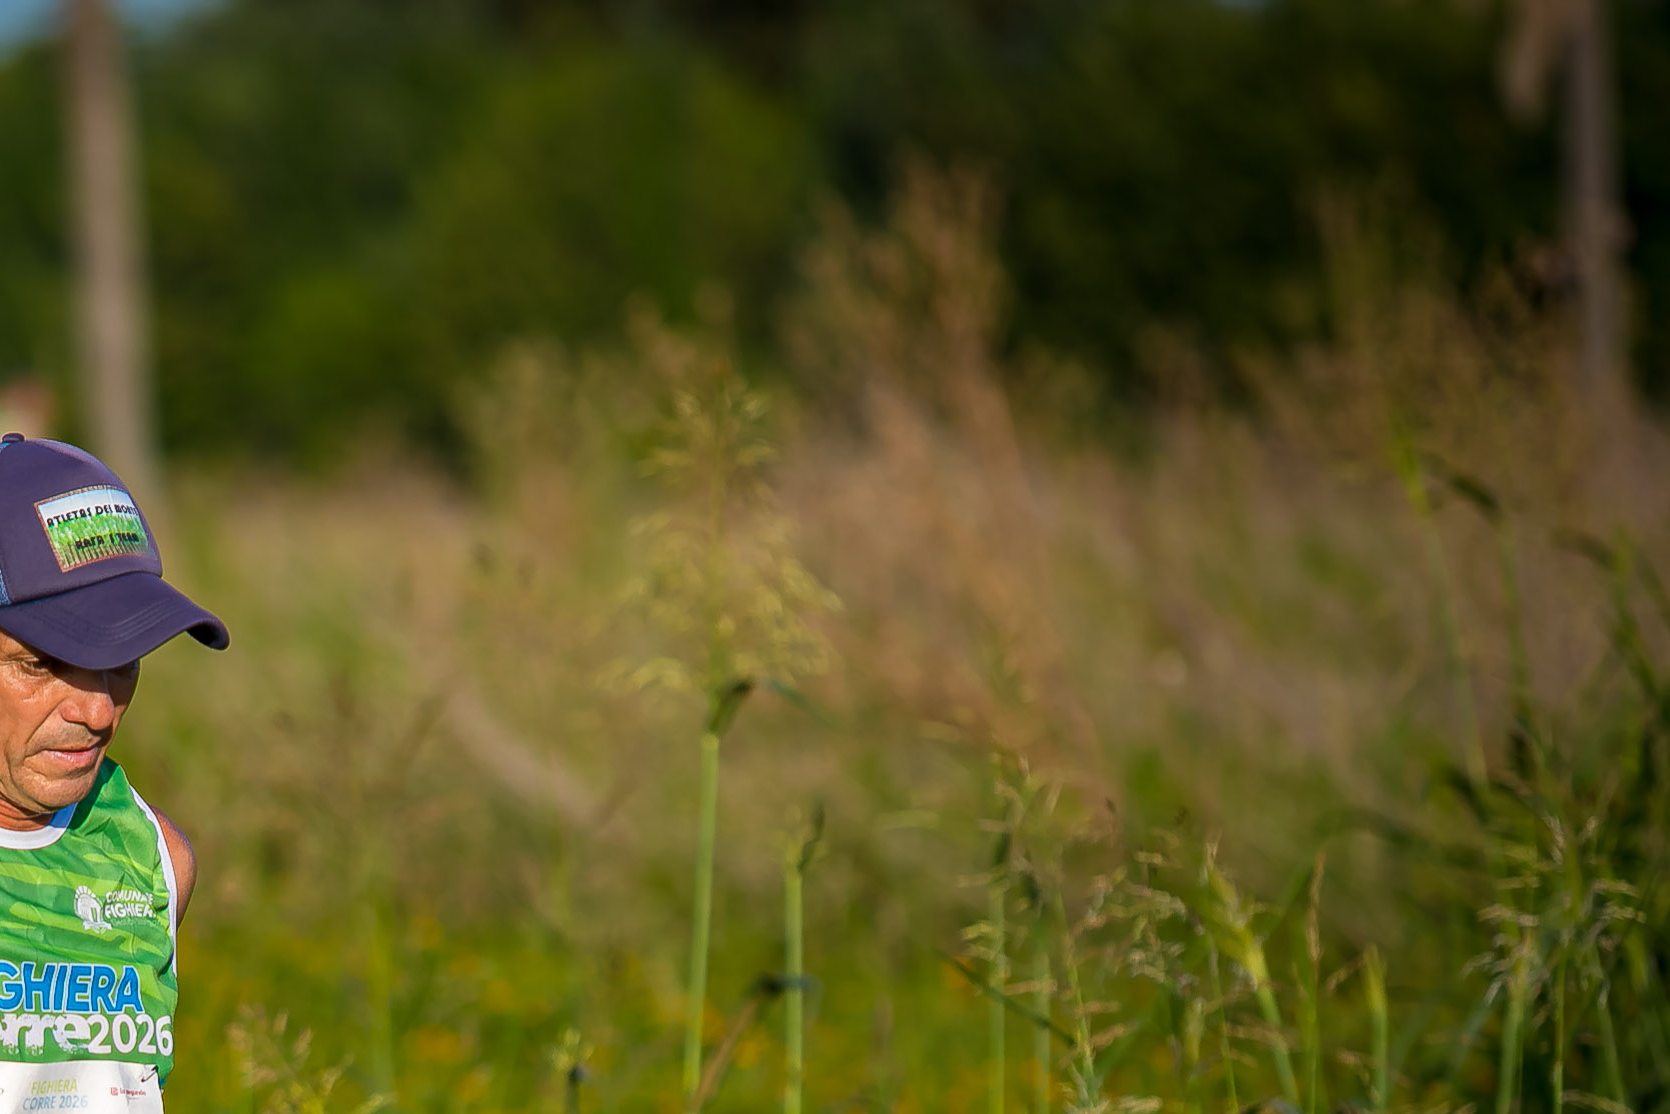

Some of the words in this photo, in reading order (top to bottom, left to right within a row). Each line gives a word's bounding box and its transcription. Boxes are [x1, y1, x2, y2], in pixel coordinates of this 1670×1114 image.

[46, 507, 92, 527] ATLETAS
[94, 504, 113, 516] DEL
[31, 1079, 78, 1095] FIGHIERA
[22, 1095, 56, 1111] CORRE
[59, 1095, 88, 1109] 2026
